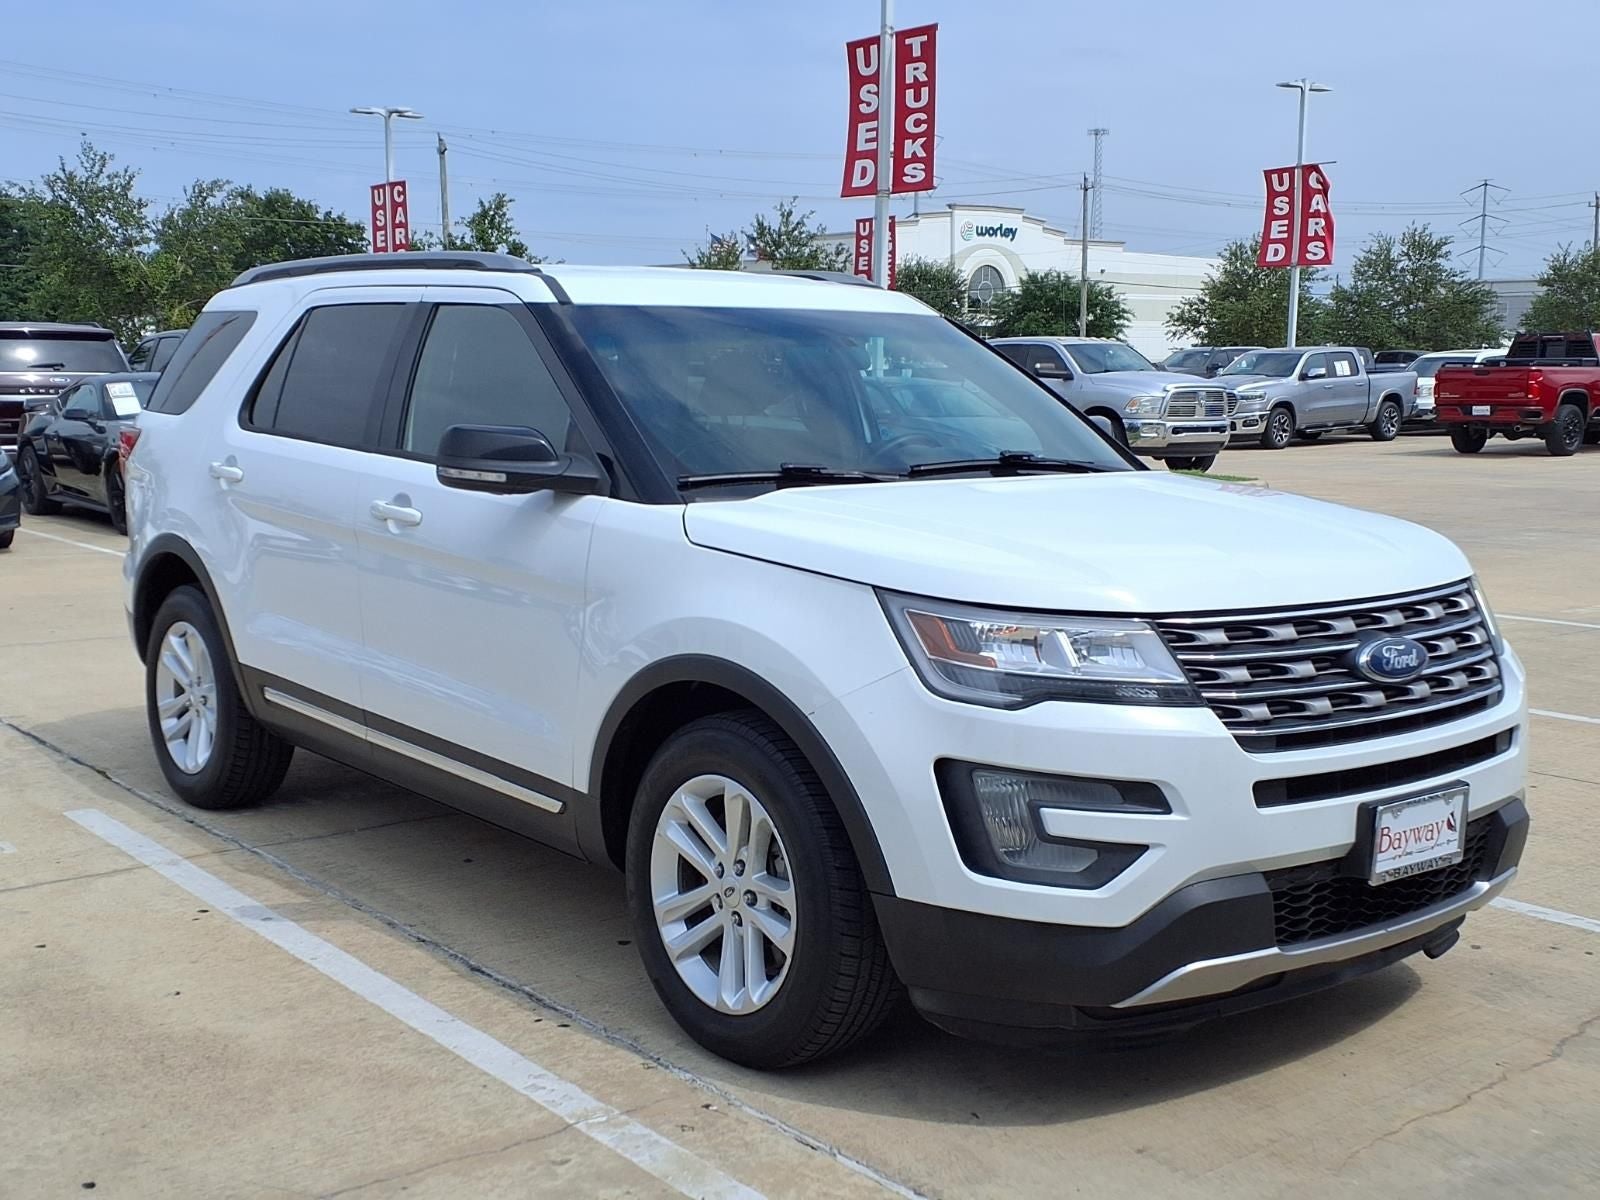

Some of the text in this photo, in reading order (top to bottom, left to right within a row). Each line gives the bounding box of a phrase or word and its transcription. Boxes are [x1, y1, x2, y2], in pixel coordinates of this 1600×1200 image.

[851, 44, 879, 188] USED
[902, 35, 929, 184] TRUCKS
[374, 188, 386, 254] USE
[393, 185, 406, 251] CAR
[975, 223, 1018, 242] worley
[1265, 172, 1290, 262] USED
[1305, 171, 1326, 260] CARS
[1382, 644, 1420, 671] Ford
[1378, 820, 1445, 855] Bayway
[1393, 857, 1442, 879] BAYWAY
